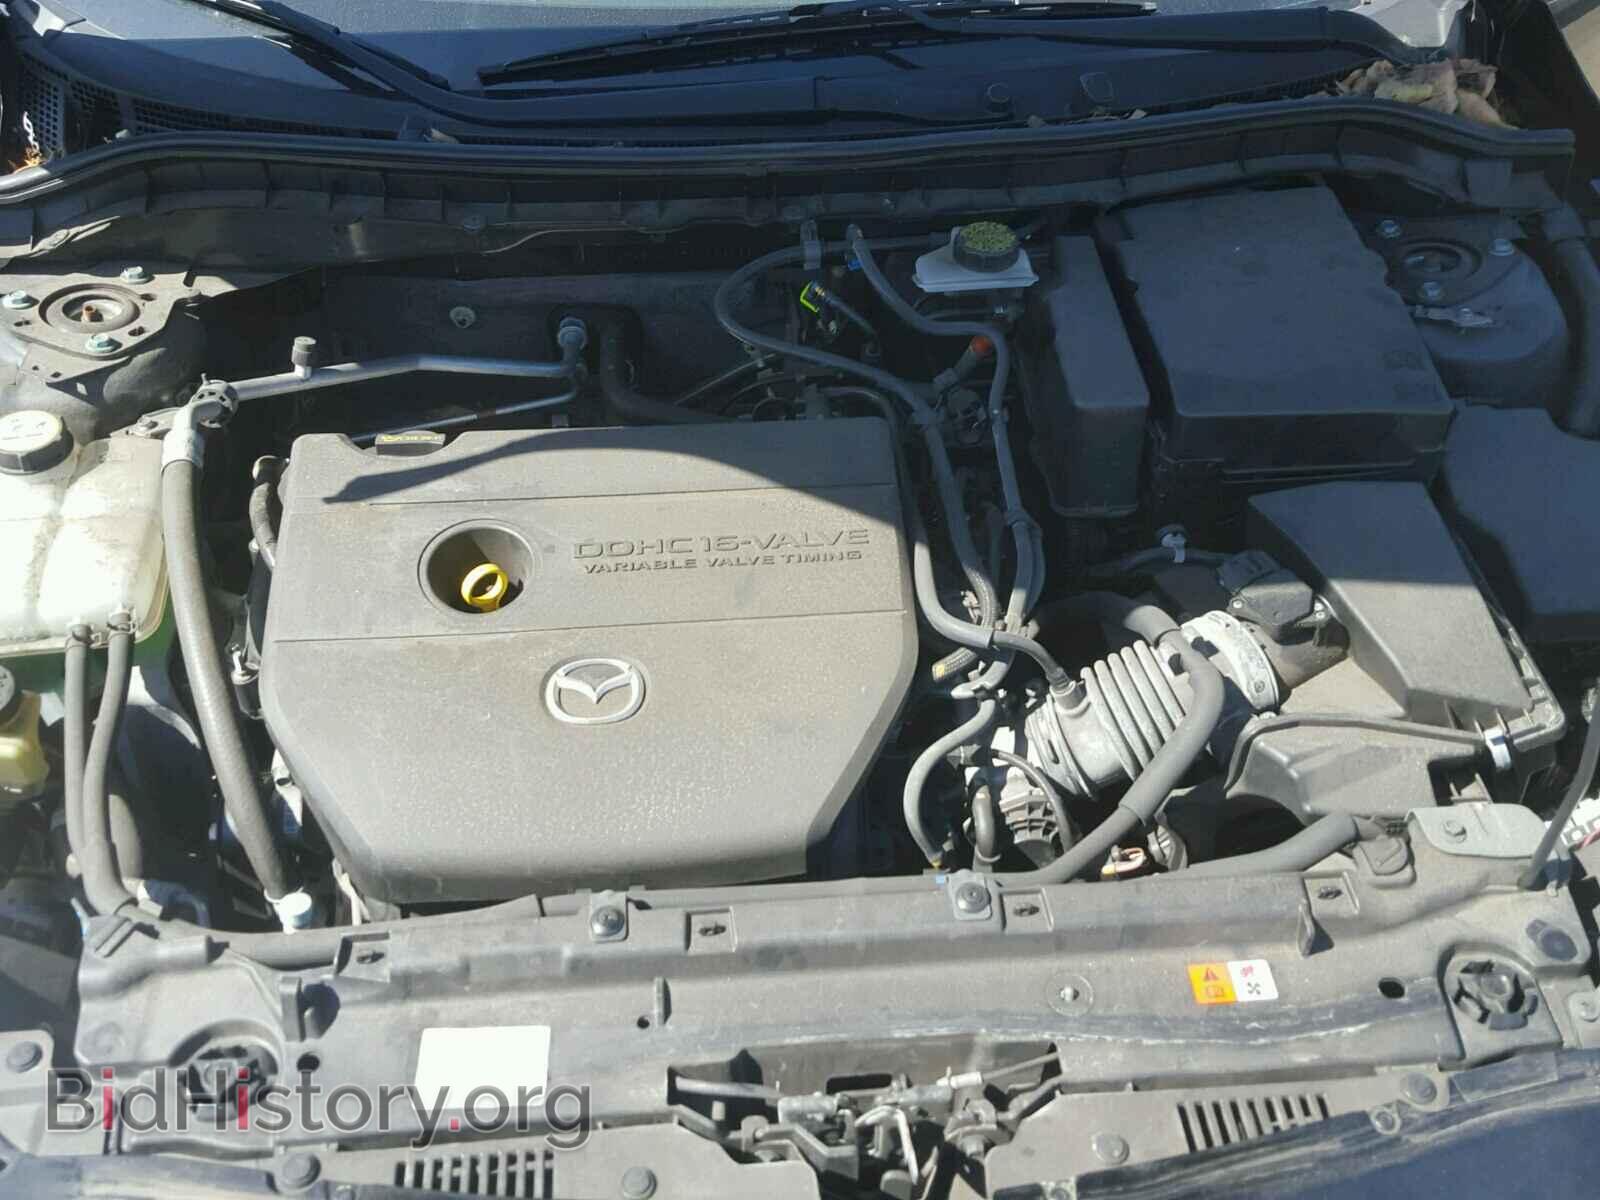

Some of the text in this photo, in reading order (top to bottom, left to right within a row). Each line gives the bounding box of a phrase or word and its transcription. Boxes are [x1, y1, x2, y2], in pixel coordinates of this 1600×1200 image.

[573, 528, 870, 559] DOHC 16-VALVE
[583, 550, 863, 574] VARIABLE VALVE TIMING
